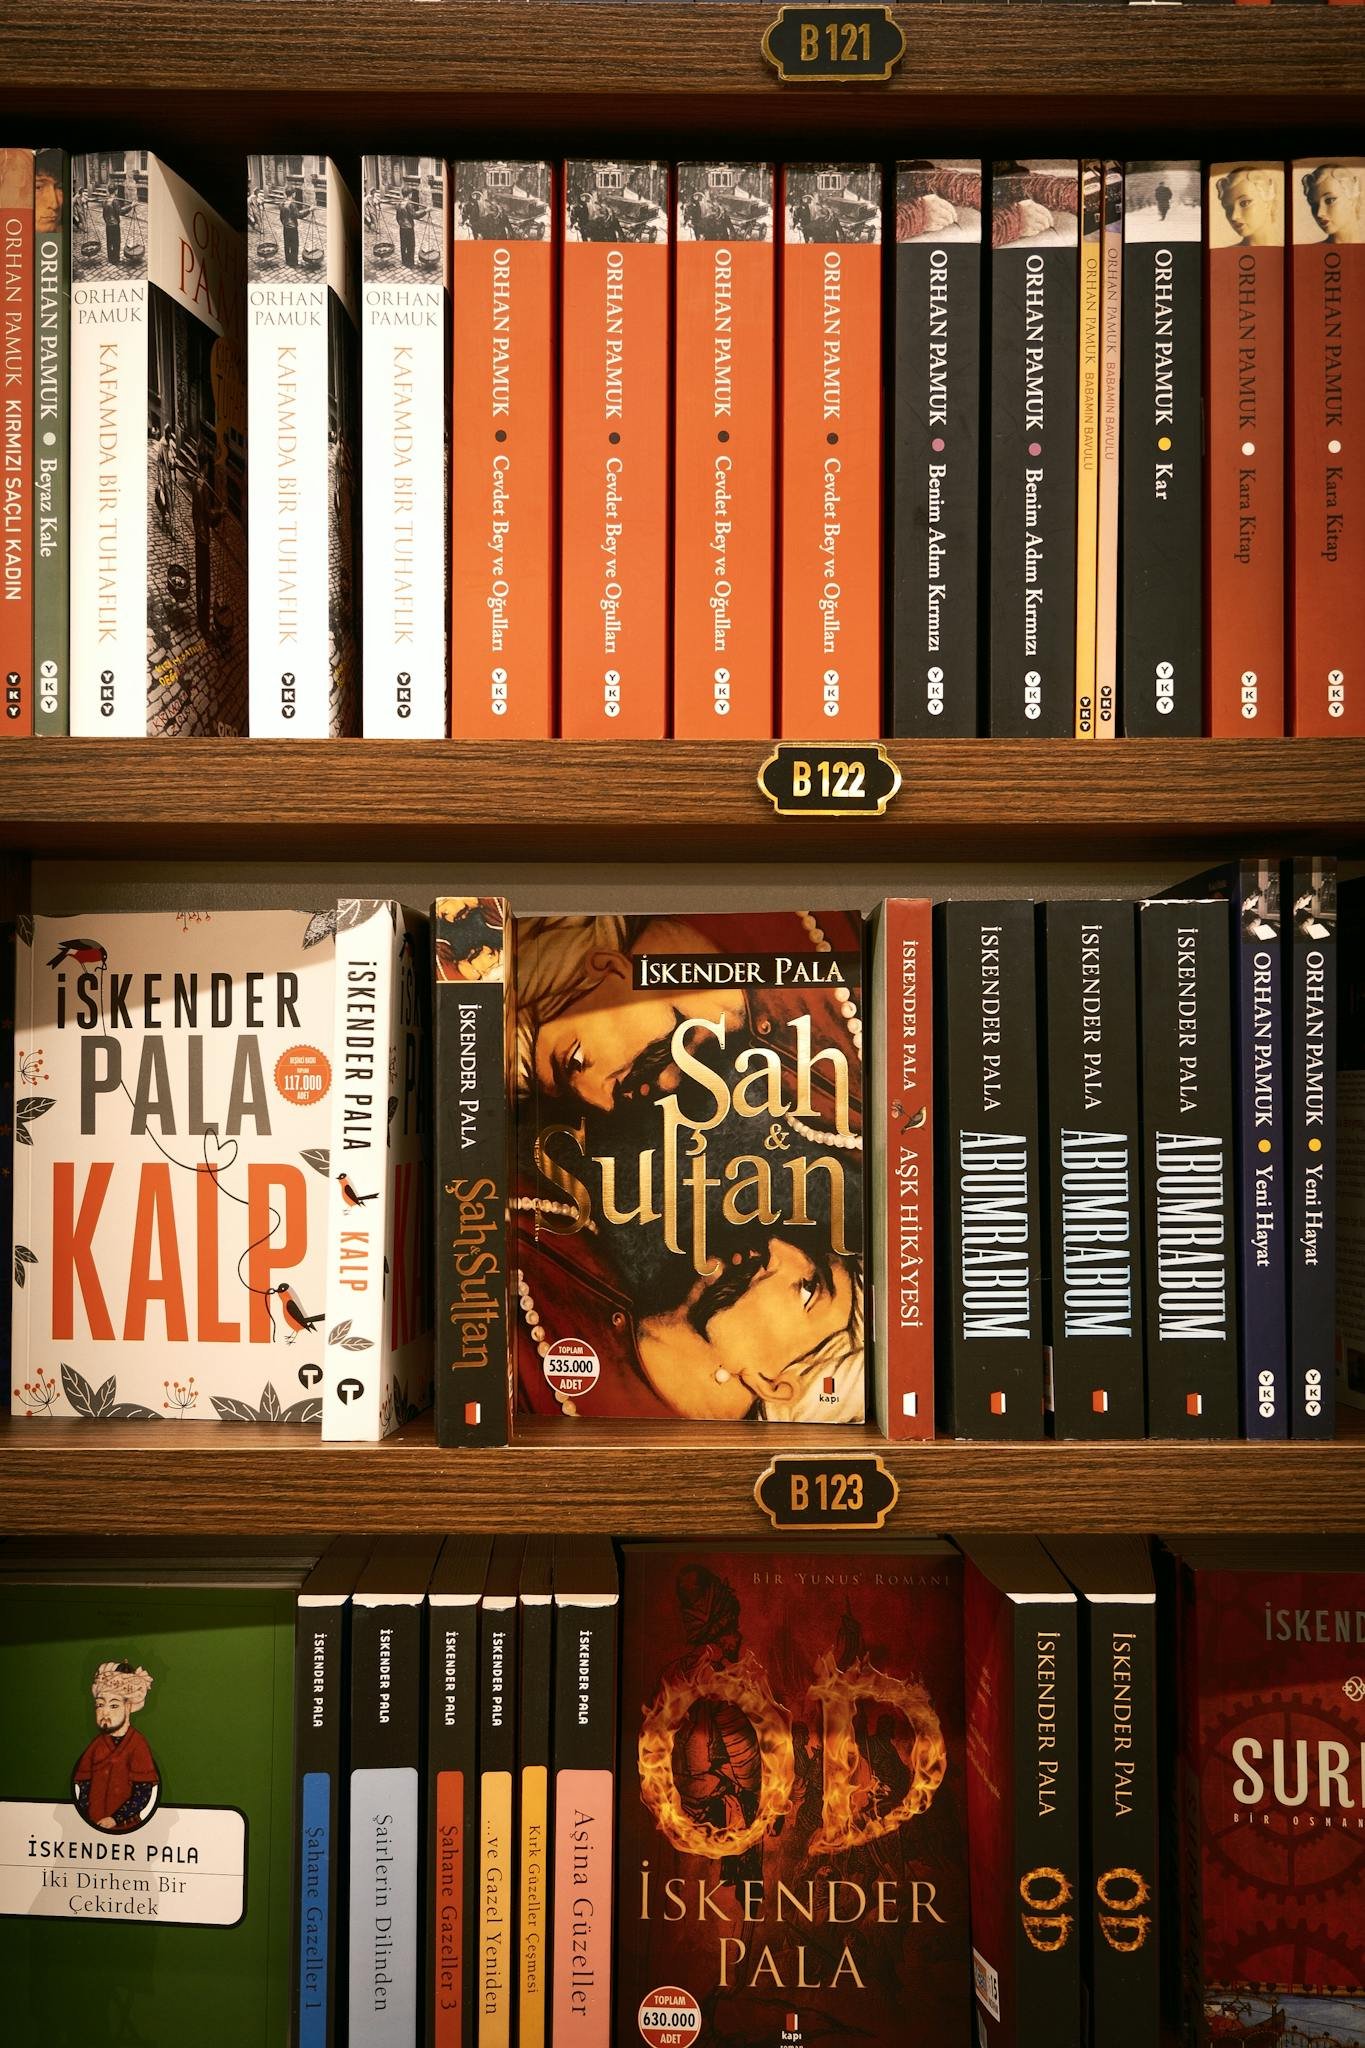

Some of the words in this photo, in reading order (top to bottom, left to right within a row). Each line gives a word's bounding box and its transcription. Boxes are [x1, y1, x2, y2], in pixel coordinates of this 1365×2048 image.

[801, 24, 819, 61] B
[826, 24, 870, 61] 121
[5, 219, 23, 303] ORHAN
[41, 240, 58, 329] ORHAN
[493, 248, 511, 332] ORHAN
[715, 248, 733, 332] ORHAN
[1086, 258, 1098, 311] ORHAN
[74, 287, 145, 306] ORHAN
[78, 309, 143, 324] PAMUK
[250, 290, 324, 307] ORHAN
[255, 311, 321, 327] PAMUK
[824, 251, 842, 335] ORHAN
[930, 250, 948, 337] ORHAN
[1155, 249, 1173, 336] ORHAN
[1239, 255, 1256, 341] ORHAN
[1324, 252, 1342, 339] ORHAN
[5, 310, 23, 387] PAMUK
[1085, 317, 1096, 364] PAMUK
[41, 335, 57, 419] PAMUK
[99, 344, 118, 466] KAFAMDA
[493, 337, 510, 417] PAMUK
[715, 337, 732, 417] PAMUK
[824, 340, 841, 420] PAMUK
[930, 343, 947, 426] PAMUK
[1084, 372, 1095, 424] BABAMIN
[1155, 342, 1173, 425] PAMUK
[1239, 346, 1256, 431] PAMUK
[1324, 344, 1343, 426] PAMUK
[5, 400, 22, 470] KIRMIZI
[278, 346, 298, 469] KAFAMDA
[1083, 427, 1094, 470] BAVULU
[3, 477, 22, 533] SAÇLI
[36, 458, 58, 512] Beyaz
[99, 474, 119, 512] BİR
[278, 477, 302, 515] BİR
[492, 455, 510, 516] Cevdet
[823, 458, 841, 519] Cevdet
[928, 463, 947, 523] Benim
[1155, 463, 1174, 501] Kar
[1239, 468, 1257, 510] Kara
[1326, 467, 1344, 508] Kara
[40, 517, 58, 558] Kale
[488, 521, 510, 554] Bey
[492, 556, 505, 576] ve
[819, 524, 841, 557] Bey
[928, 528, 946, 579] Adım
[1233, 514, 1257, 565] Kitap
[1321, 512, 1344, 563] Kitap
[5, 540, 22, 600] KADIN
[98, 518, 118, 643] TUHAFLIK
[277, 521, 298, 646] TUHAFLIK
[823, 559, 836, 579] ve
[487, 581, 510, 652] Oğulları
[818, 584, 841, 655] Oğulları
[928, 584, 946, 652] Kırmızı
[793, 761, 811, 796] B
[818, 761, 865, 797] 122
[640, 953, 765, 986] İSKENDER
[774, 958, 845, 984] PALA
[902, 940, 918, 1039] İSKENDER
[981, 926, 1002, 1046] İSKENDER
[1178, 928, 1199, 1047] İSKENDER
[1254, 951, 1272, 1038] ORHAN
[1306, 951, 1323, 1038] ORHAN
[458, 1003, 480, 1093] İSKENDER
[903, 1044, 918, 1091] PALA
[81, 1035, 272, 1136] PALA
[285, 1074, 322, 1091] 117.000
[983, 1054, 1001, 1112] PALA
[1180, 1056, 1198, 1113] PALA
[1255, 1044, 1273, 1127] PAMUK
[1306, 1043, 1324, 1126] PAMUK
[344, 1094, 373, 1151] PALA
[459, 1100, 480, 1149] PALA
[764, 1124, 790, 1150] &
[536, 1096, 858, 1275] Sultan
[895, 1146, 919, 1197] AŞK
[1255, 1164, 1273, 1207] Yeni
[1305, 1163, 1323, 1206] Yeni
[52, 1162, 307, 1343] KALP
[339, 1231, 370, 1291] KALP
[960, 1130, 1031, 1339] ABUMRABUM
[1156, 1131, 1227, 1341] ABUMRABUM
[1251, 1211, 1274, 1267] Hayat
[1300, 1210, 1323, 1266] Hayat
[901, 1203, 923, 1328] HİKÂYESİ
[450, 1252, 500, 1371] Sultan
[549, 1359, 593, 1373] 535.000
[559, 1346, 584, 1355] TOPLAM
[560, 1378, 583, 1390] ADET
[791, 1474, 809, 1510] B
[815, 1474, 864, 1511] 123
[313, 1698, 323, 1727] PALA
[379, 1693, 390, 1723] PALA
[445, 1695, 455, 1725] PALA
[492, 1696, 502, 1726] PALA
[578, 1695, 589, 1724] PALA
[1037, 1631, 1061, 1752] İSKENDER
[1112, 1632, 1137, 1753] İSKENDER
[1038, 1760, 1059, 1817] PALA
[1114, 1761, 1136, 1817] PALA
[1232, 1738, 1365, 1809] SUR
[28, 1834, 136, 1861] İSKENDER
[147, 1846, 199, 1865] PALA
[304, 1826, 325, 1898] Şahane
[372, 1814, 393, 1908] Şairlerin
[439, 1826, 459, 1897] Şahane
[529, 1825, 541, 1857] Kırk
[569, 1809, 595, 1886] Aşina
[42, 1869, 68, 1888] İki
[76, 1872, 151, 1893] Dirhem
[159, 1876, 187, 1894] Bir
[69, 1895, 159, 1917] Çekirdek
[486, 1868, 503, 1923] Gazel
[527, 1865, 540, 1927] Güzeller
[640, 1860, 948, 1924] İSKENDER
[1019, 1867, 1074, 1952] OD
[1097, 1867, 1152, 1952] OD
[305, 1907, 323, 1992] Gazeller
[374, 1917, 393, 2011] Dilinden
[441, 1906, 459, 1991] Gazeller
[485, 1933, 503, 2014] Yeniden
[525, 1933, 540, 1993] Çeşmesi
[571, 1898, 594, 2016] Güzeller
[718, 1938, 867, 1989] PALA
[441, 2000, 457, 2010] 3
[643, 2011, 696, 2028] 630.000
[654, 1995, 686, 2005] TOPLAM
[660, 2034, 682, 2044] ADET
